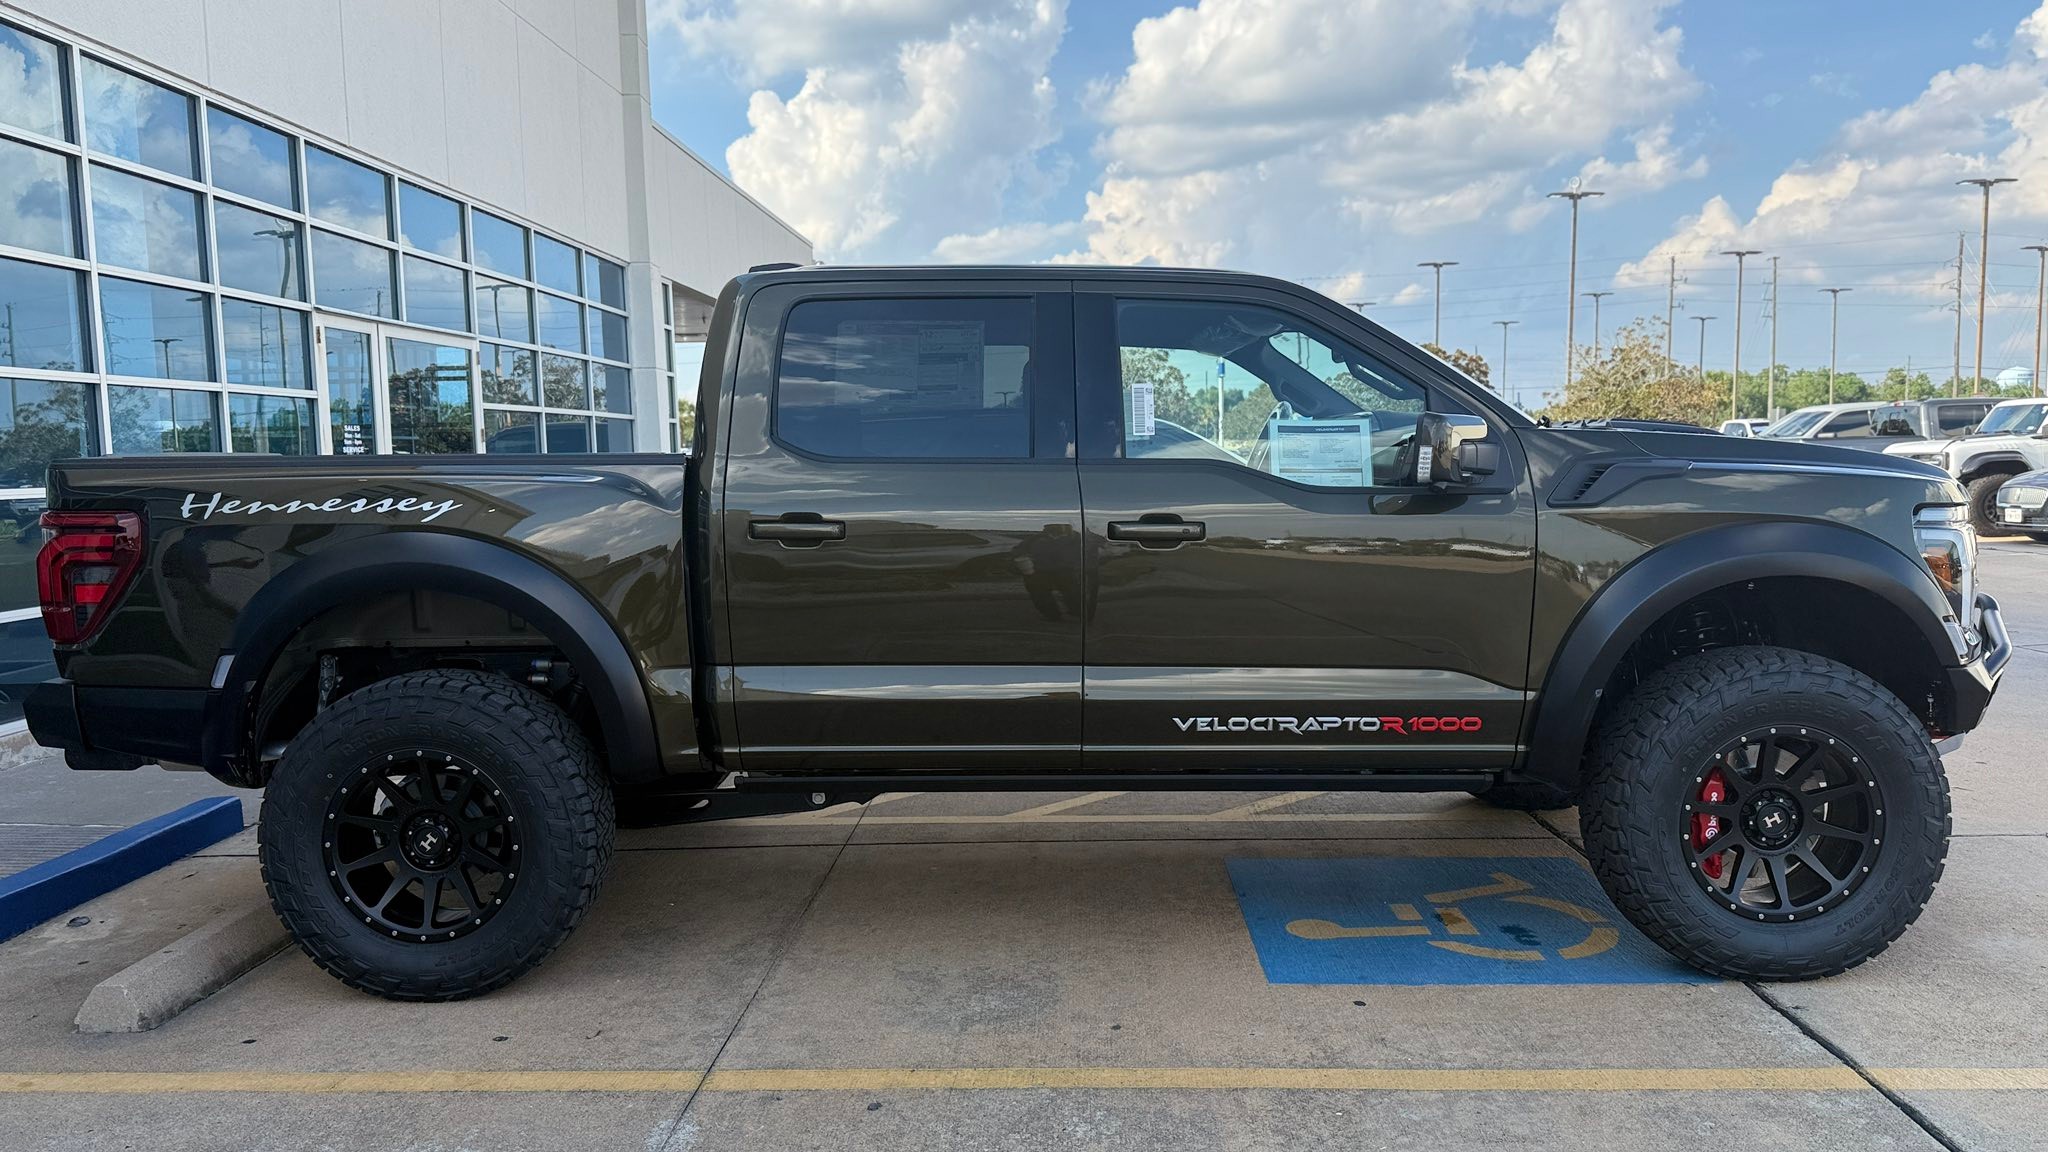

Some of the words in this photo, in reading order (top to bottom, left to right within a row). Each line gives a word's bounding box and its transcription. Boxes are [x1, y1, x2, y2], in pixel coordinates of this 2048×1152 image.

[181, 493, 463, 522] Hennessey
[1172, 717, 1407, 735] VELOCIRAPTOR
[1408, 717, 1482, 732] 1000
[1763, 813, 1784, 829] H
[418, 833, 438, 852] H
